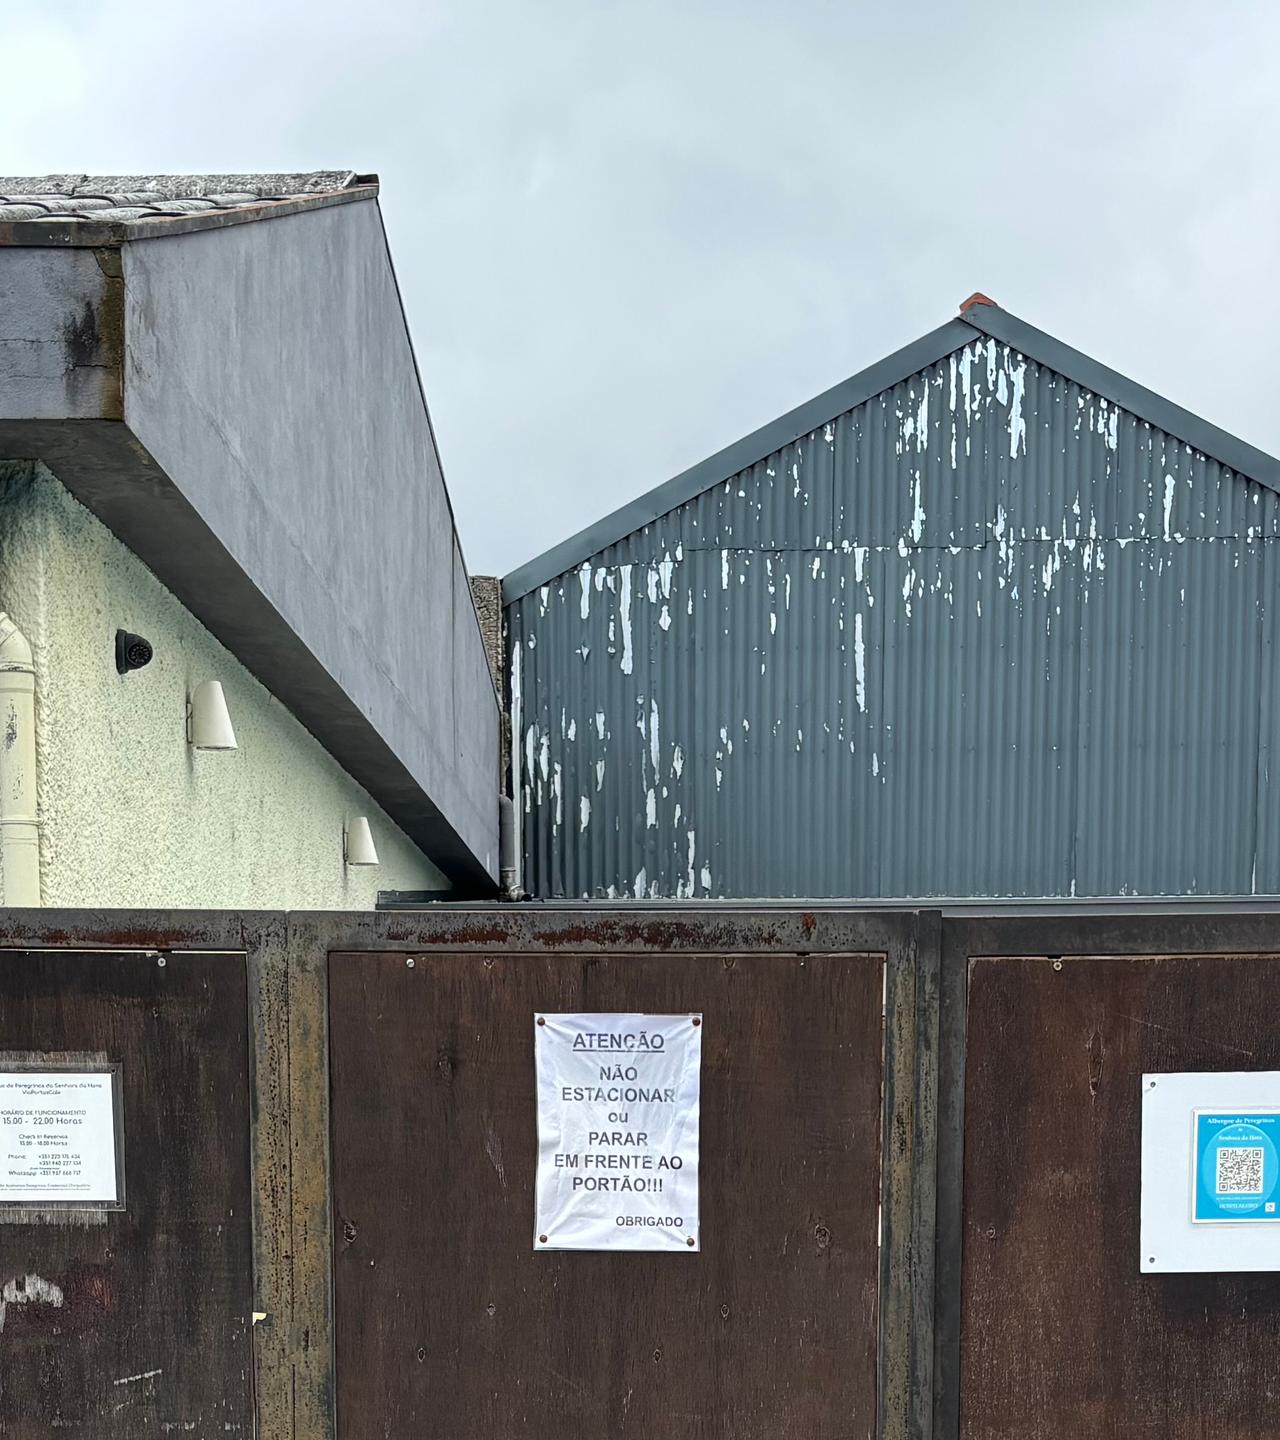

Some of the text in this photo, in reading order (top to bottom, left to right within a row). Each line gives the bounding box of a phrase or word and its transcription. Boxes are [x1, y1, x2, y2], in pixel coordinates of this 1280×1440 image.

[573, 1031, 665, 1051] ATENÇÃO
[599, 1064, 638, 1081] NÃO
[562, 1087, 675, 1103] ESTACIONAR
[608, 1112, 629, 1123] ou
[588, 1132, 648, 1146] PARAR
[554, 1154, 683, 1170] EM FRENTE AO
[572, 1175, 663, 1193] PORTÃO!!!
[616, 1216, 684, 1227] OBRIGADO
